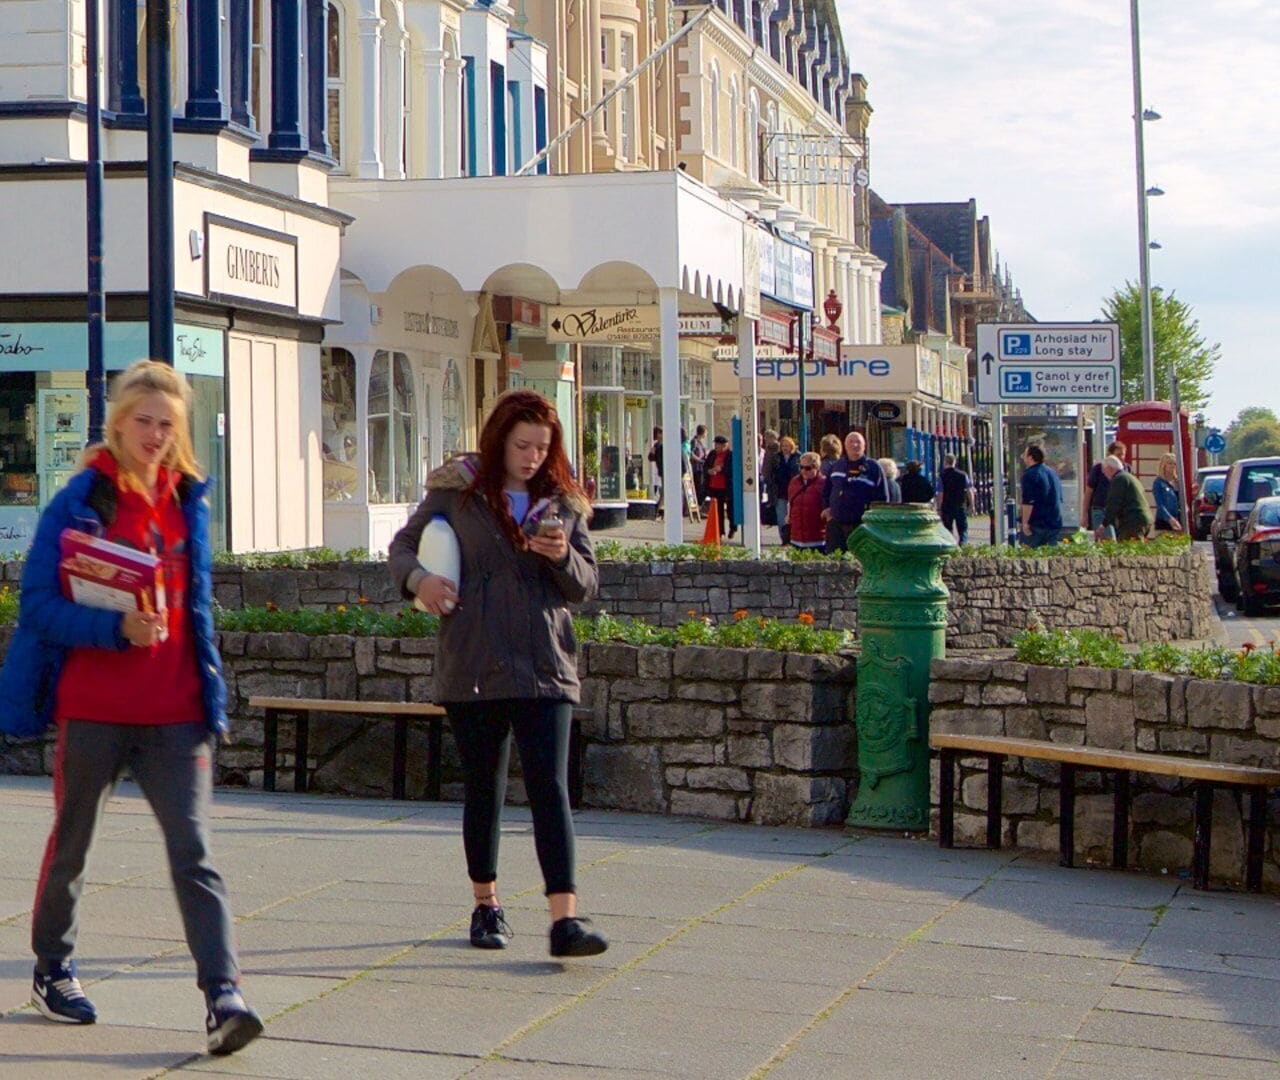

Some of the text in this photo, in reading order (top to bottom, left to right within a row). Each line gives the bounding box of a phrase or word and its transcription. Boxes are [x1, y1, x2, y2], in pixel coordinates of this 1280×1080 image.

[226, 243, 280, 289] GIMBERTS
[1007, 336, 1021, 354] P
[1035, 334, 1107, 344] Arhosiad hir
[1035, 346, 1093, 357] Long stay
[1008, 373, 1022, 391] P
[1035, 371, 1110, 383] Canol y dref
[1036, 384, 1109, 393] Town centre
